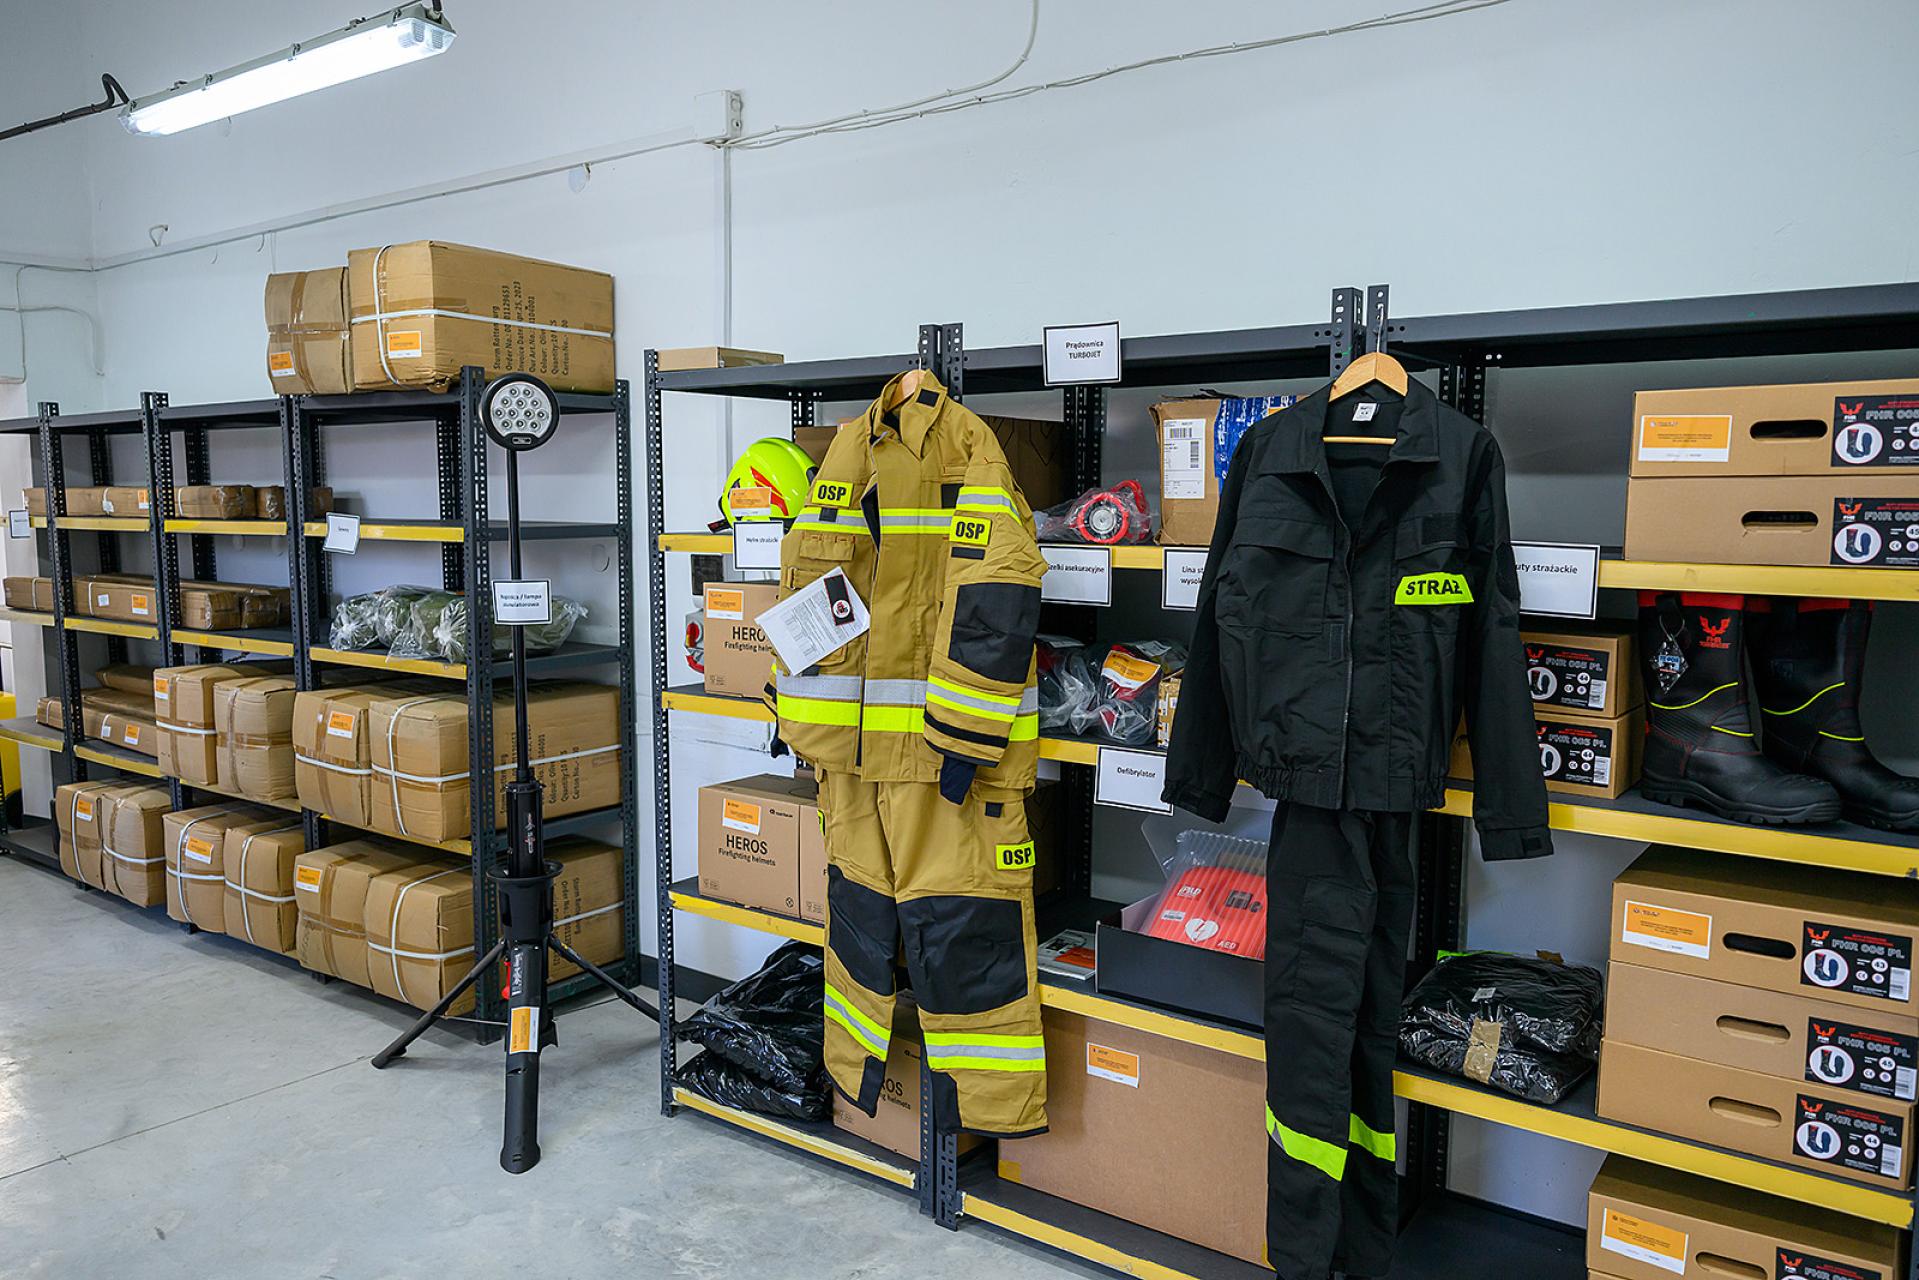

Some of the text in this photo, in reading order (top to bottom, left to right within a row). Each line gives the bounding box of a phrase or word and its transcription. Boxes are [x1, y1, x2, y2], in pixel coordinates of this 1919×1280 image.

[1066, 340, 1104, 350] Prądownica
[505, 350, 513, 371] Order
[1068, 351, 1101, 359] TURBOJET
[818, 484, 847, 501] OSP
[956, 521, 985, 539] OSP
[1065, 565, 1105, 574] asekuracyjne
[1515, 564, 1578, 574] uty strażackie
[733, 626, 767, 642] HERO
[724, 641, 757, 653] Firefighting
[1117, 766, 1156, 778] Defibrylator
[726, 834, 768, 855] HEROS
[718, 847, 776, 867] Firefighting helmets
[1003, 847, 1031, 865] OSP
[1217, 940, 1237, 949] AED
[1832, 939, 1858, 951] FHR
[1887, 946, 1905, 959] PL
[1838, 1036, 1865, 1049] FHR
[1893, 1046, 1911, 1059] PL
[1825, 1112, 1852, 1126] FHR
[1879, 1124, 1897, 1137] PL
